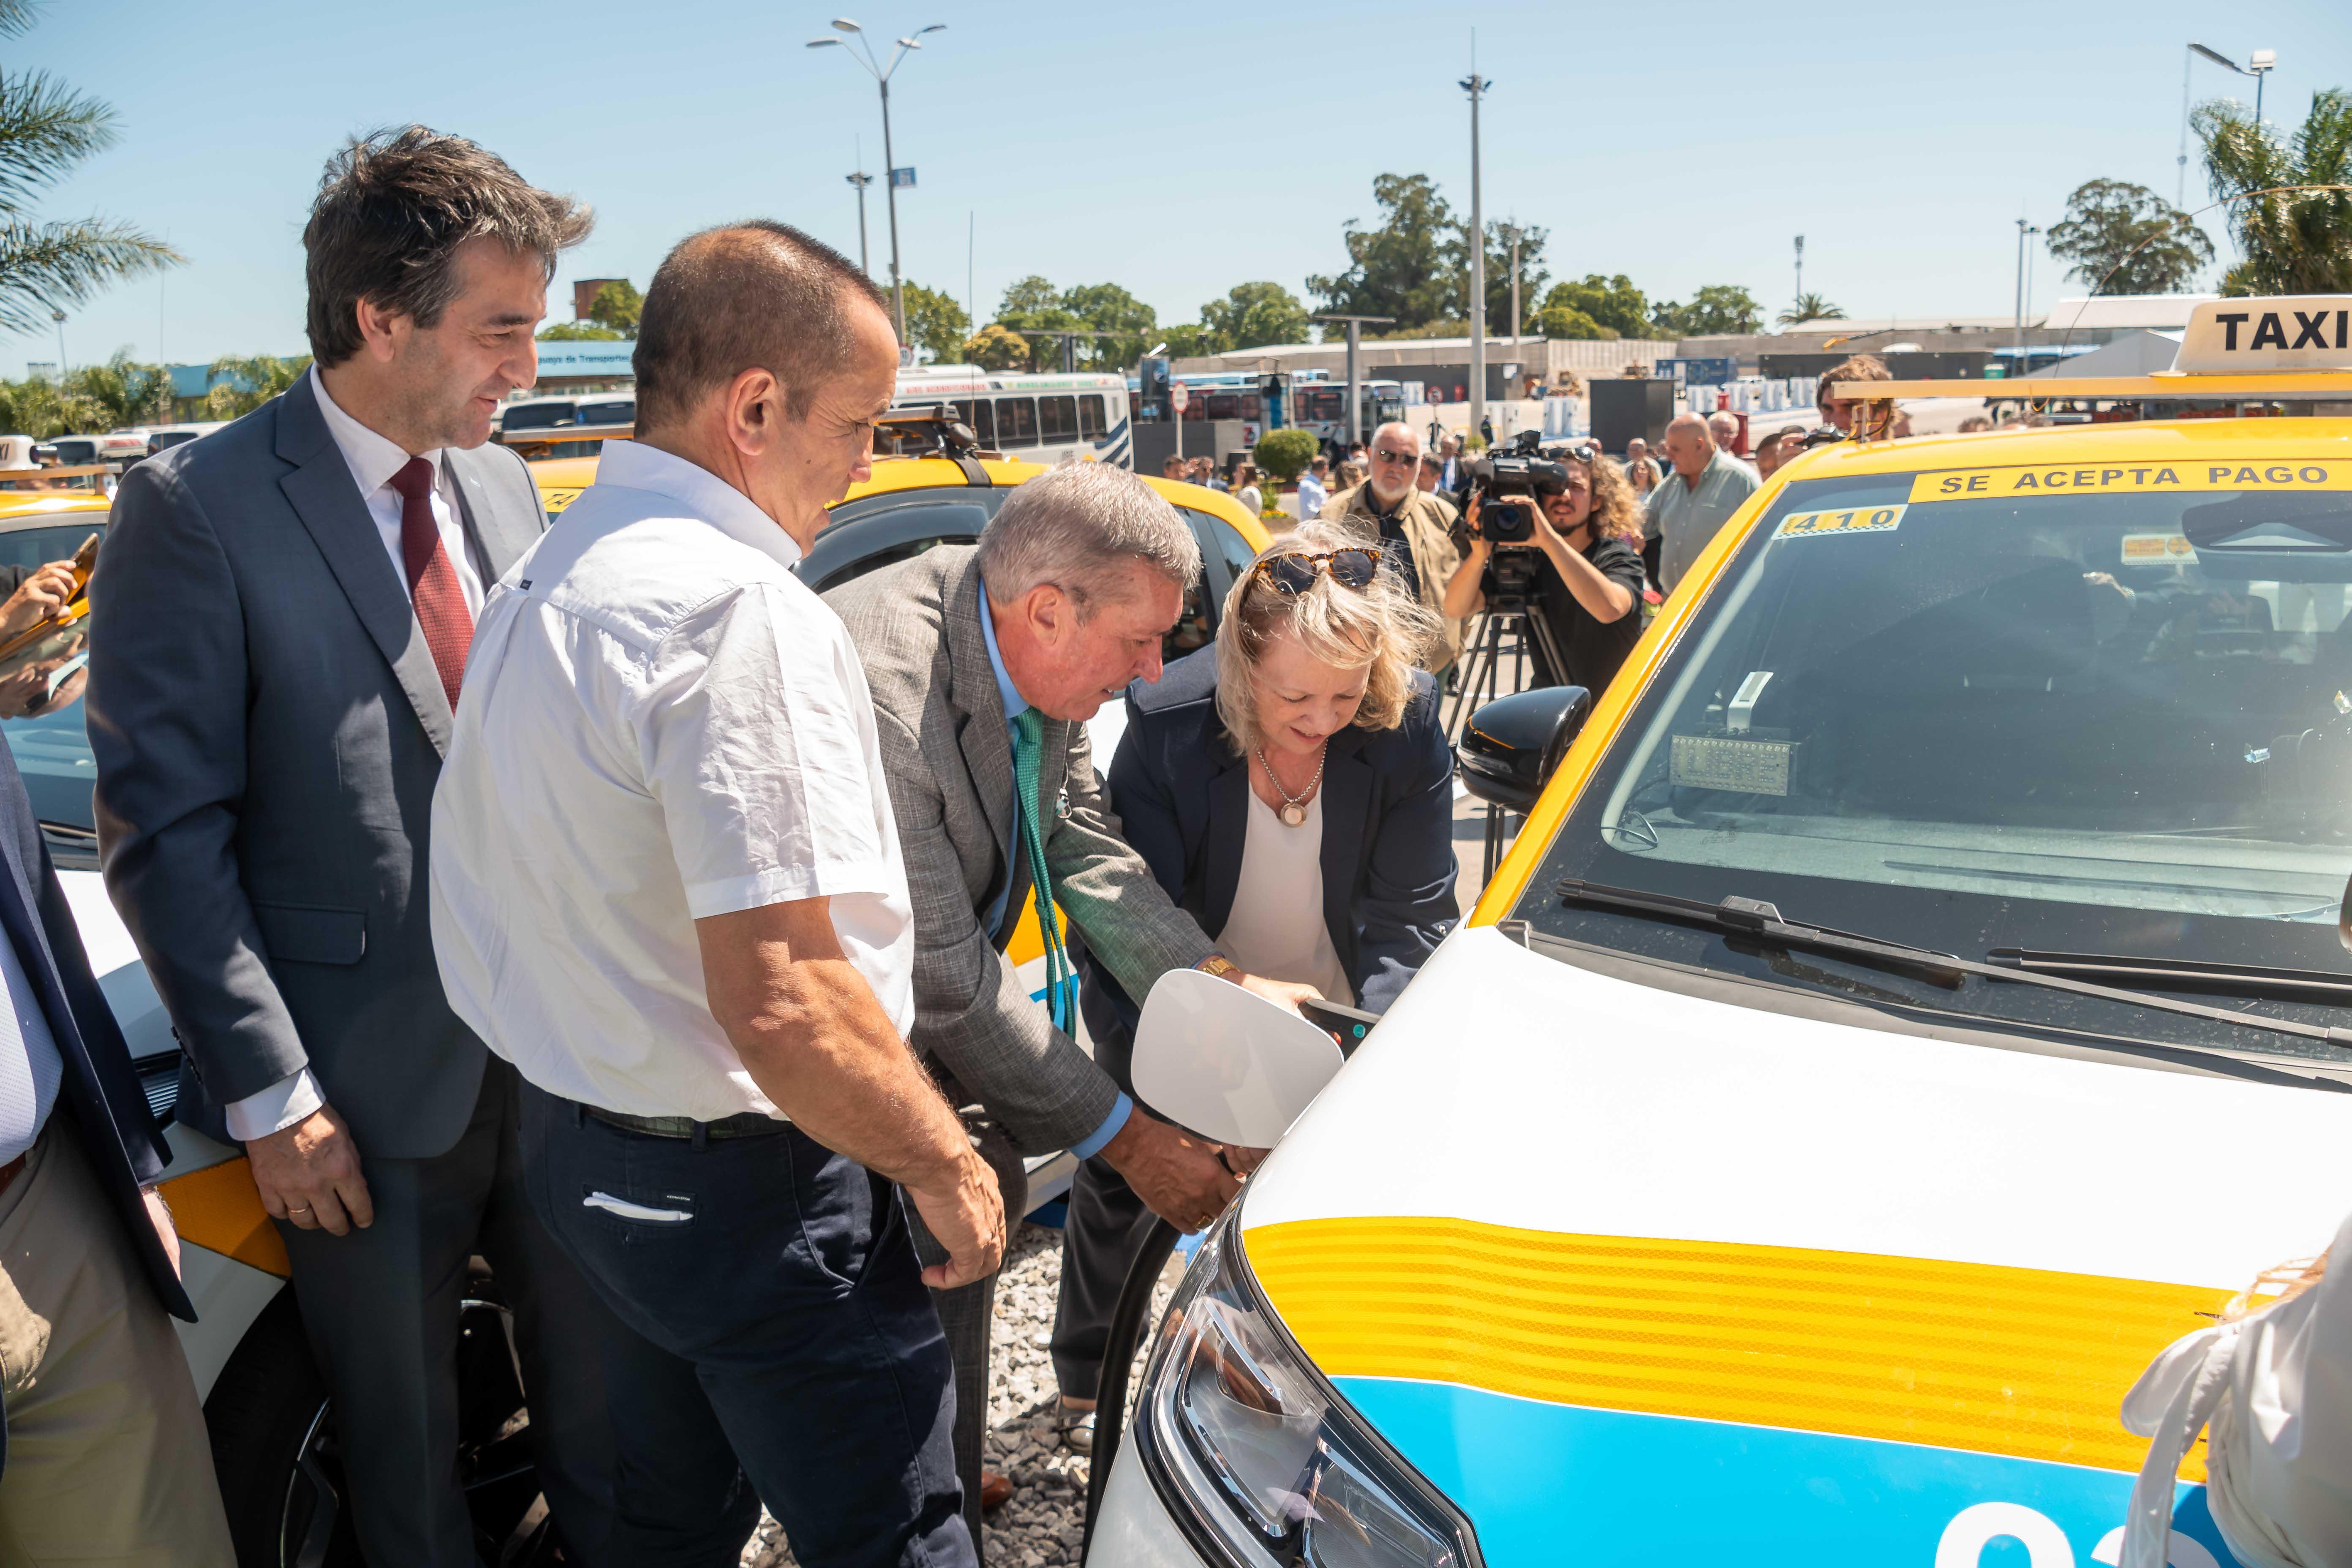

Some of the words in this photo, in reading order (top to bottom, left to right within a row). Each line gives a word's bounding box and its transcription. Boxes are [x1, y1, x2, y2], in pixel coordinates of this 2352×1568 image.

[2216, 311, 2348, 351] TAXI
[1940, 475, 1990, 493] SE
[2013, 468, 2180, 489] ACEPTA
[2209, 466, 2328, 483] PAGO
